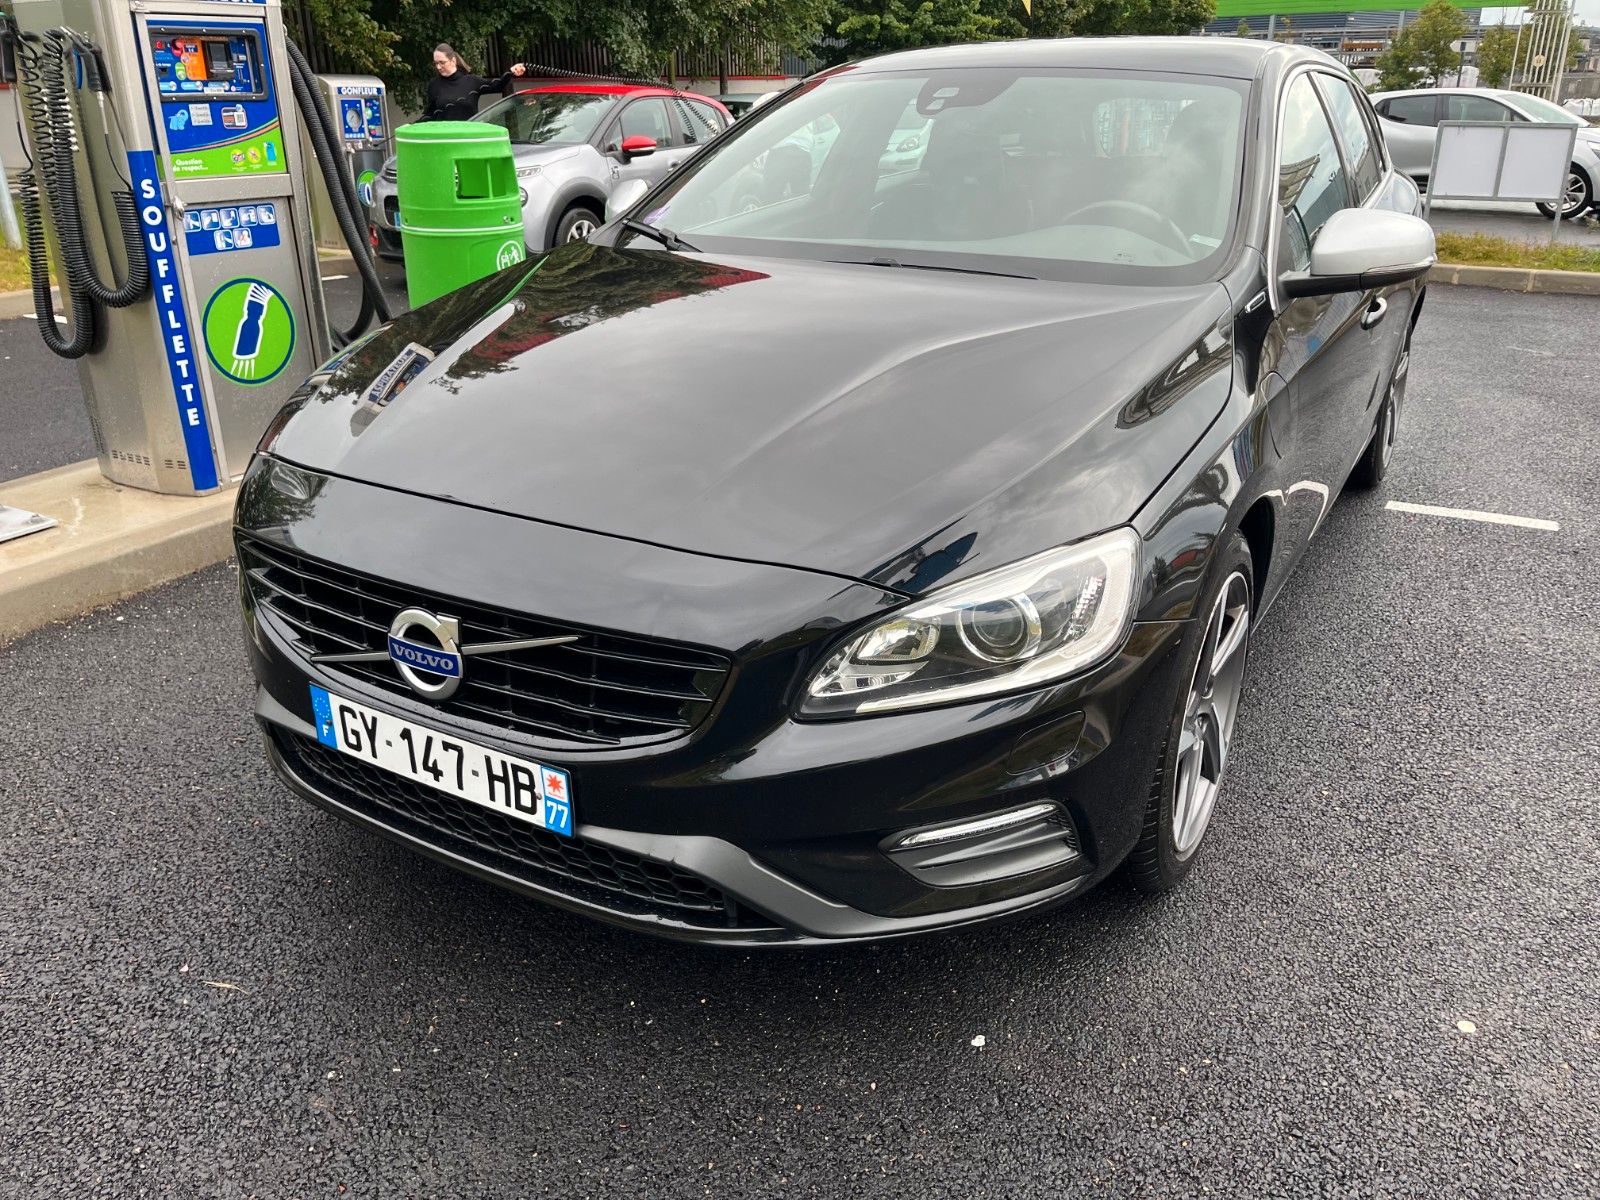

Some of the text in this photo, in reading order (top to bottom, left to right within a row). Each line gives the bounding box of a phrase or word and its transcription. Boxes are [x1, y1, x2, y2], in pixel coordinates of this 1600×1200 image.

[341, 86, 378, 95] GONFLEUR
[140, 178, 200, 427] SOUFFLETTE
[391, 642, 454, 671] VOLVO
[322, 724, 329, 738] F
[338, 704, 538, 816] GY-147-HB
[547, 800, 569, 829] 77
